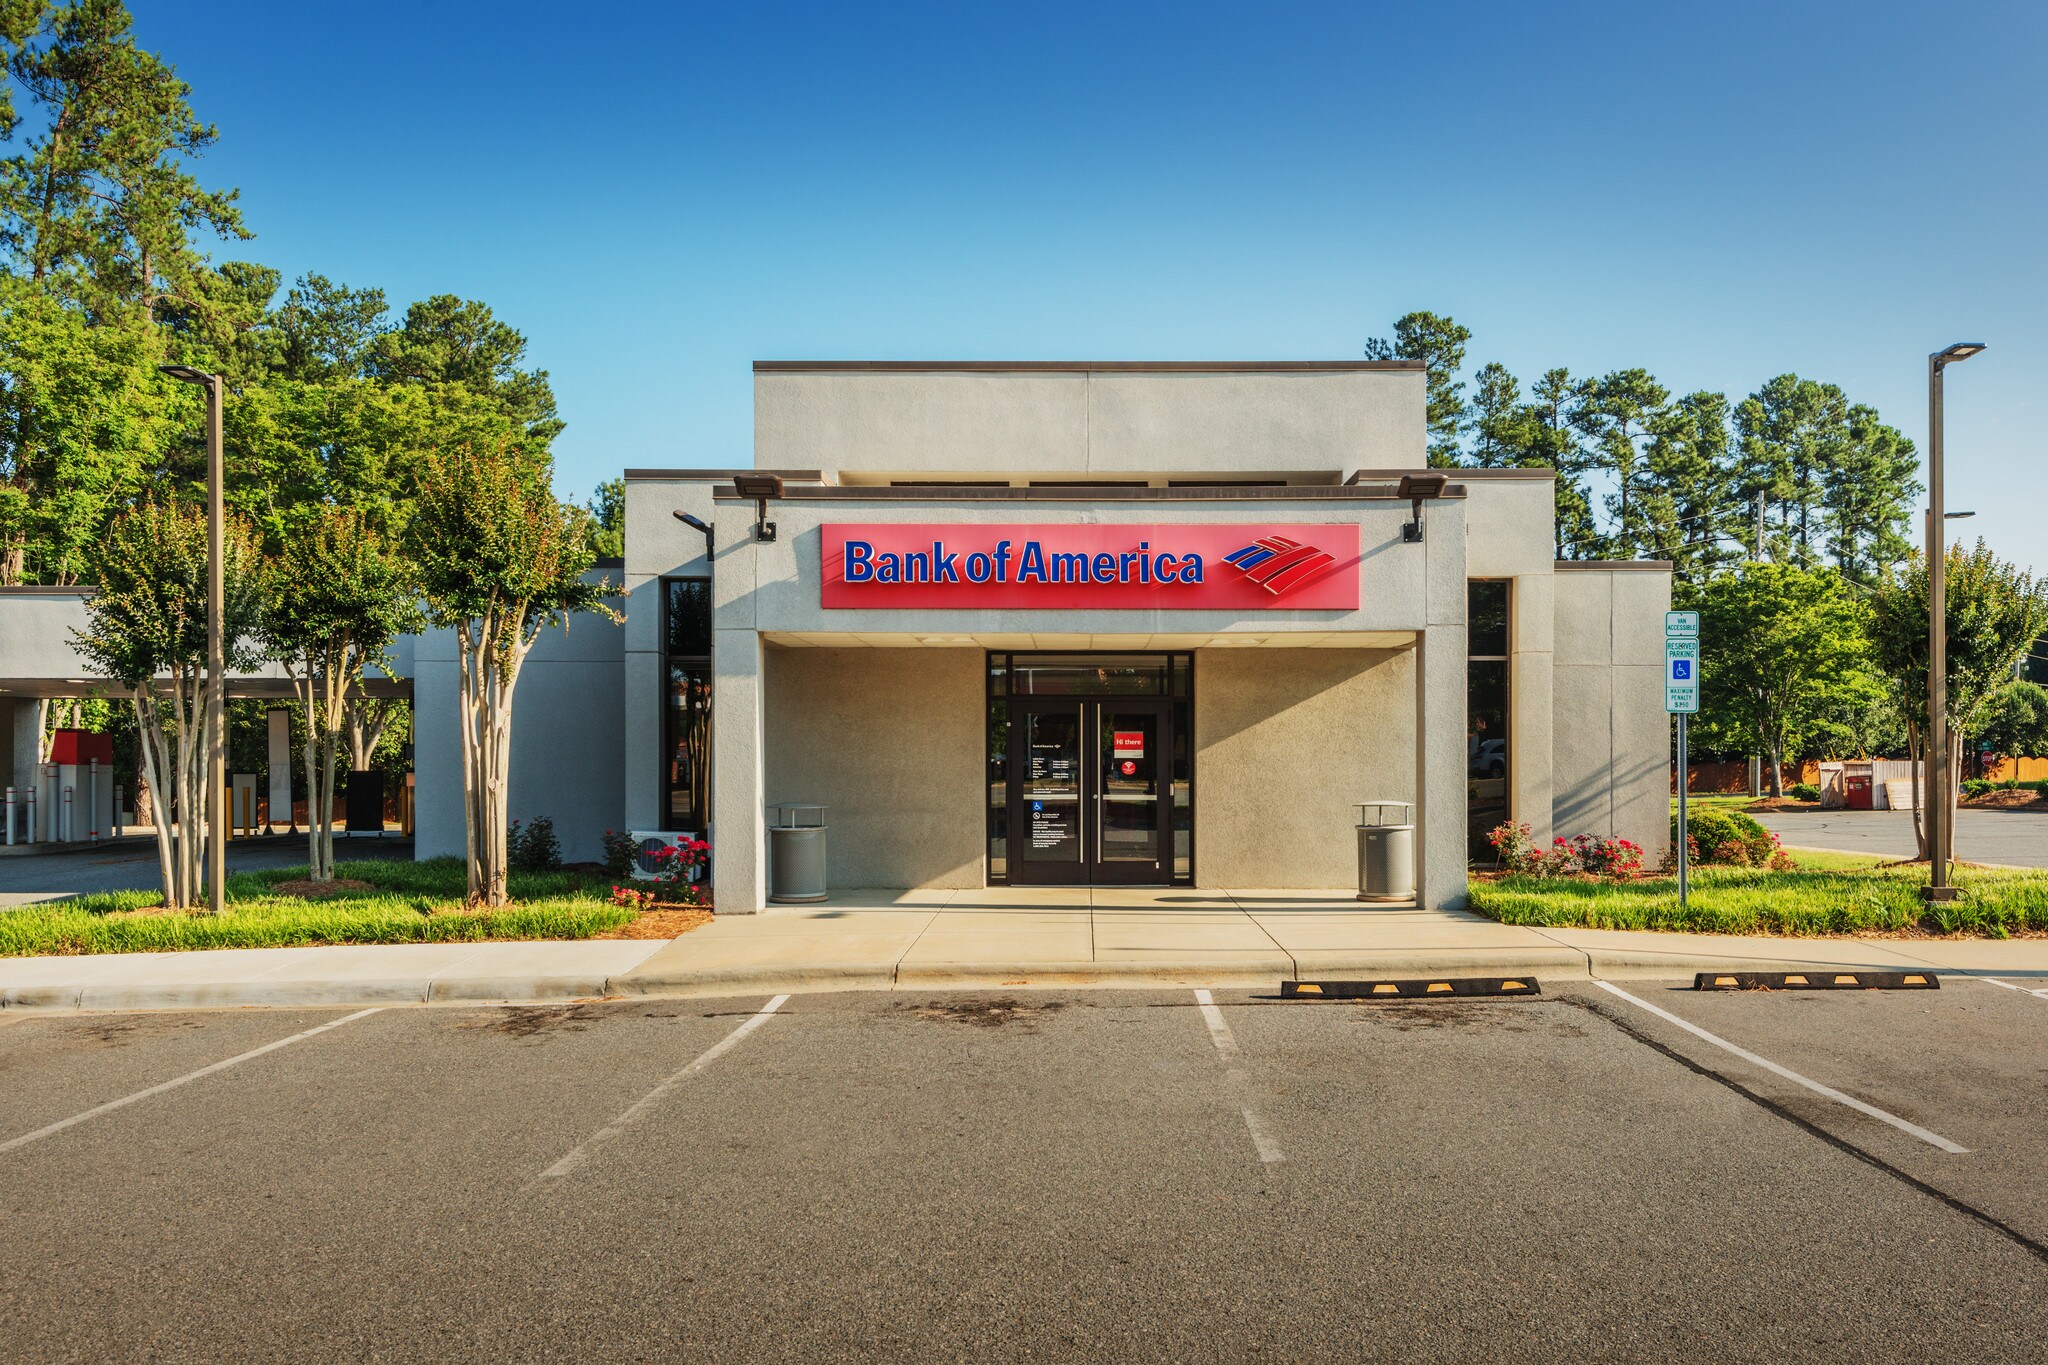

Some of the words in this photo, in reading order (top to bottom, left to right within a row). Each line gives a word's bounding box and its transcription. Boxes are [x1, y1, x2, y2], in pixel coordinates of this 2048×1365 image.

[844, 540, 960, 583] Bank
[965, 540, 1011, 583] of
[1016, 541, 1204, 584] America
[1667, 642, 1696, 650] RESERVED
[1669, 650, 1695, 658] PARKING
